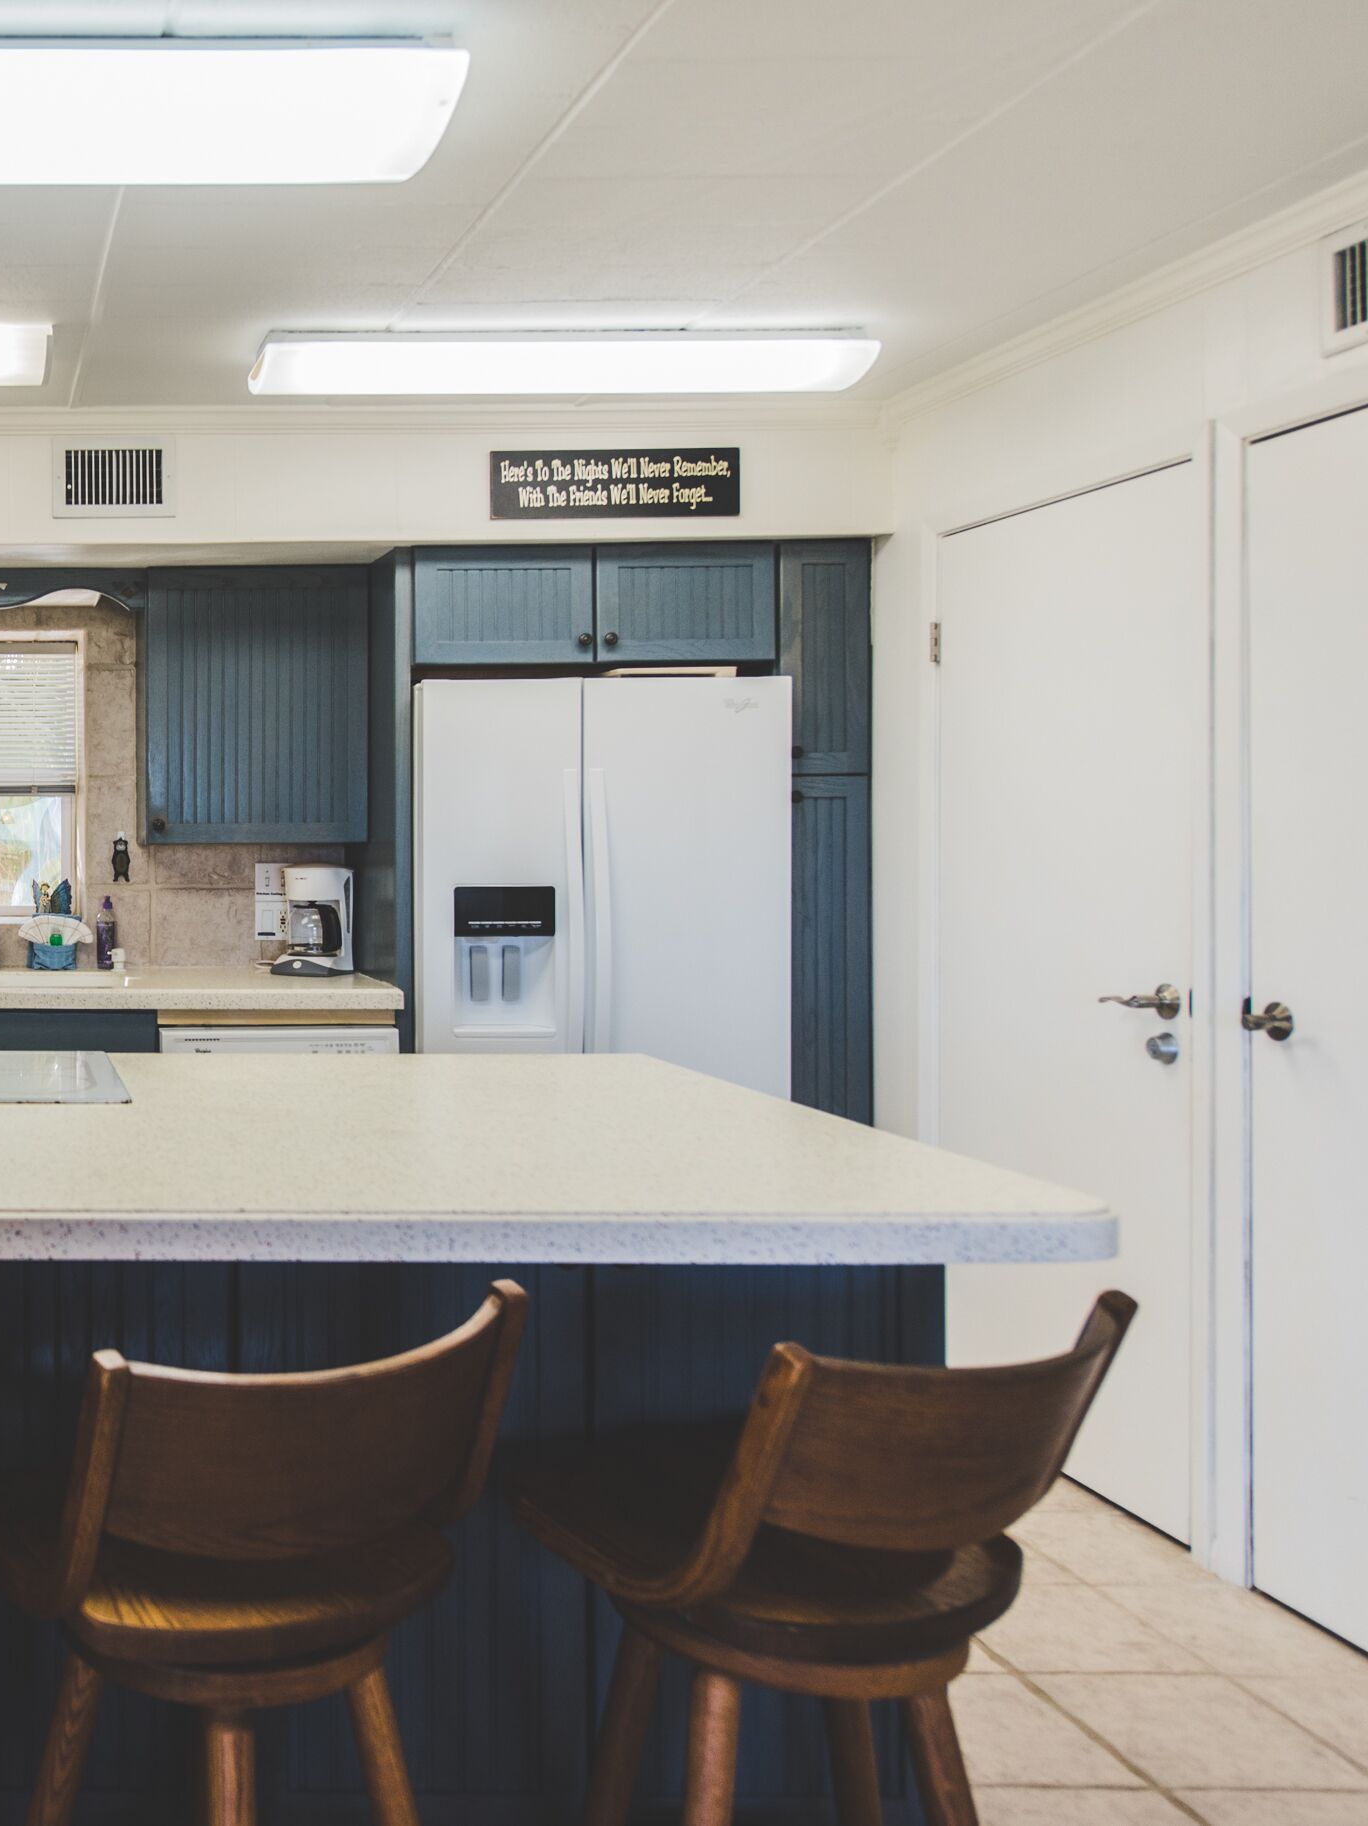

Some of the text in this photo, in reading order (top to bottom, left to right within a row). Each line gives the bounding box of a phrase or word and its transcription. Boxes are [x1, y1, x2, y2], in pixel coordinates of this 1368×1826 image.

[500, 455, 731, 487] Here's To The Nights We'll Never Remember,
[518, 486, 545, 508] With
[547, 485, 567, 507] The
[569, 484, 608, 506] Friends
[610, 483, 637, 505] We'll
[639, 483, 670, 504] Never
